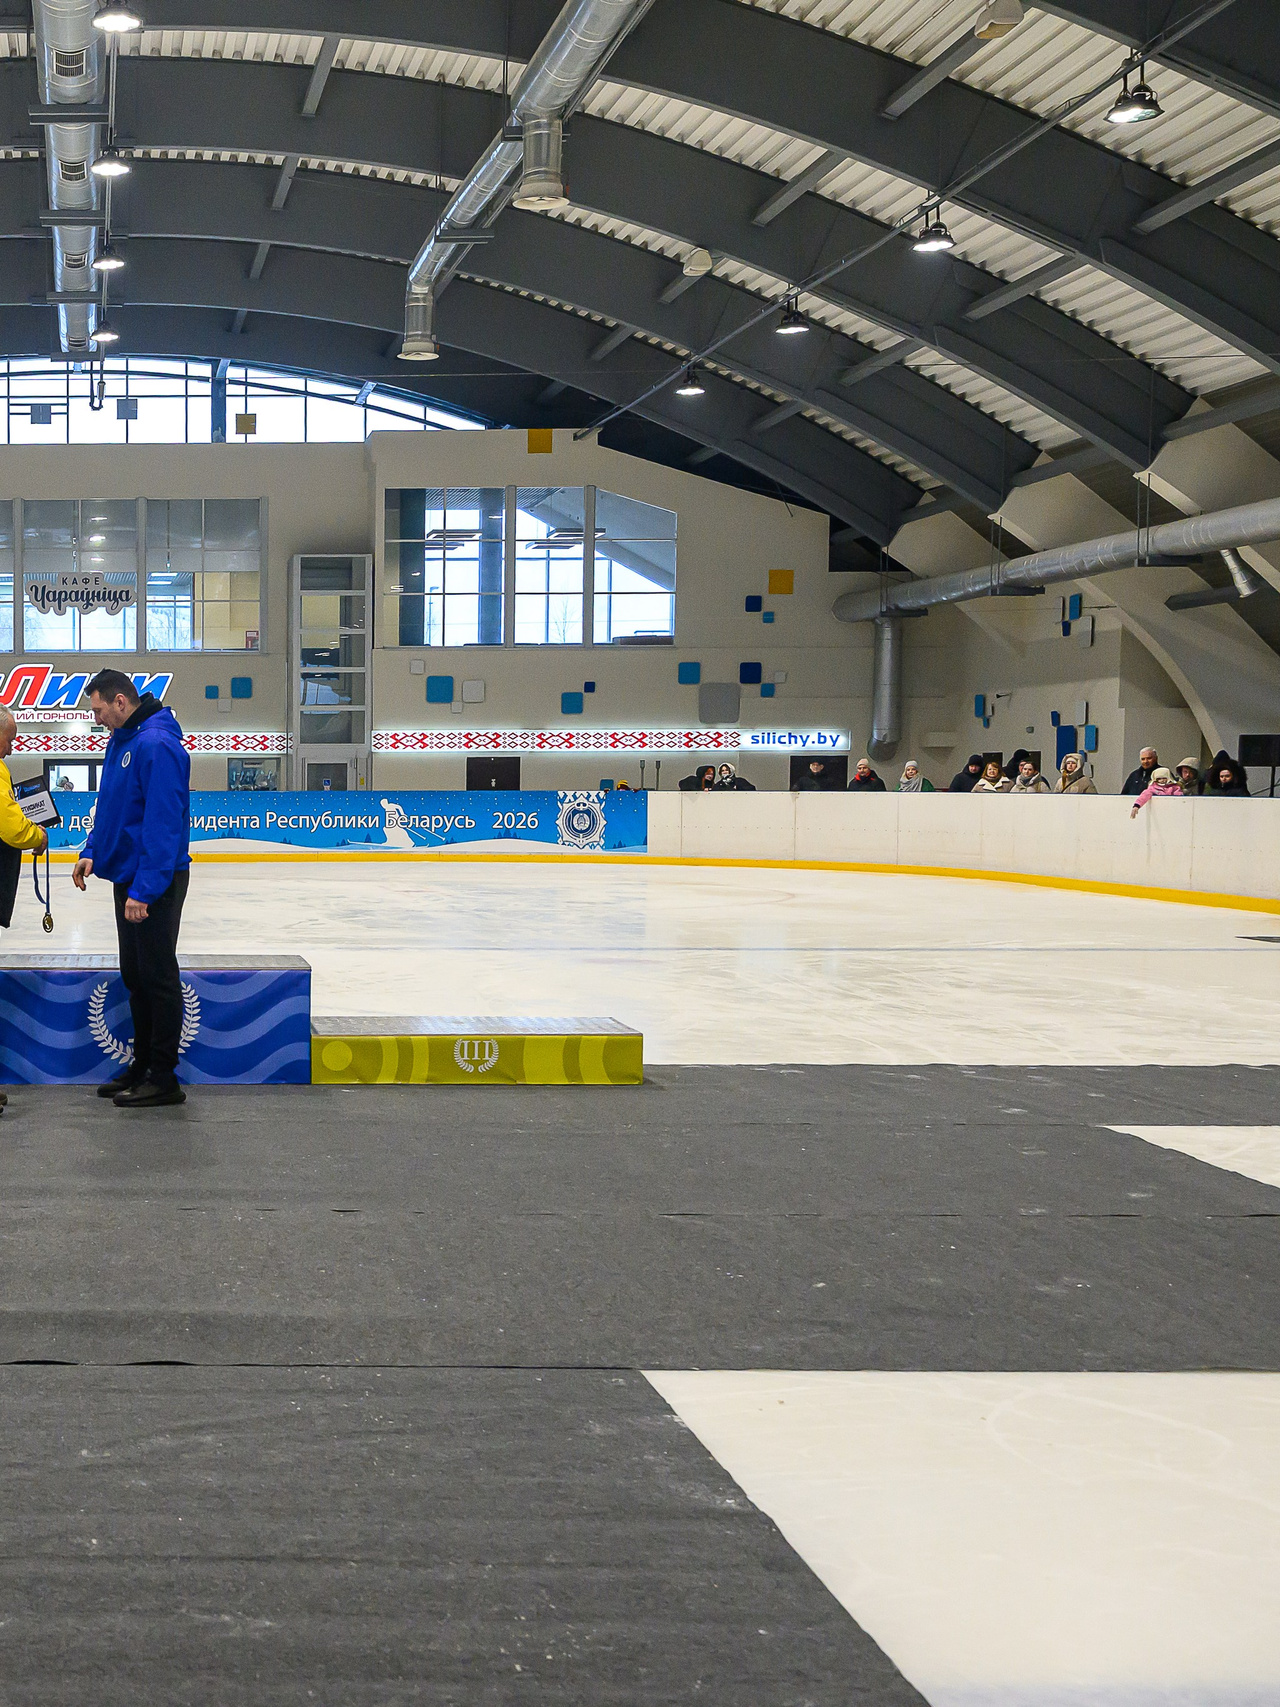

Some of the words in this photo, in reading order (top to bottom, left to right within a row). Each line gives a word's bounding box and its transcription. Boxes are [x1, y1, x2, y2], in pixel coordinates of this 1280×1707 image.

[61, 577, 100, 586] КАФЕ
[30, 584, 133, 611] Чараўніца
[36, 712, 94, 720] ГОРНОЛЫ
[750, 732, 841, 747] silichy.by
[265, 810, 380, 833] Республики
[384, 810, 477, 833] Беларусь
[491, 811, 540, 830] 2026
[461, 1040, 493, 1060] III
